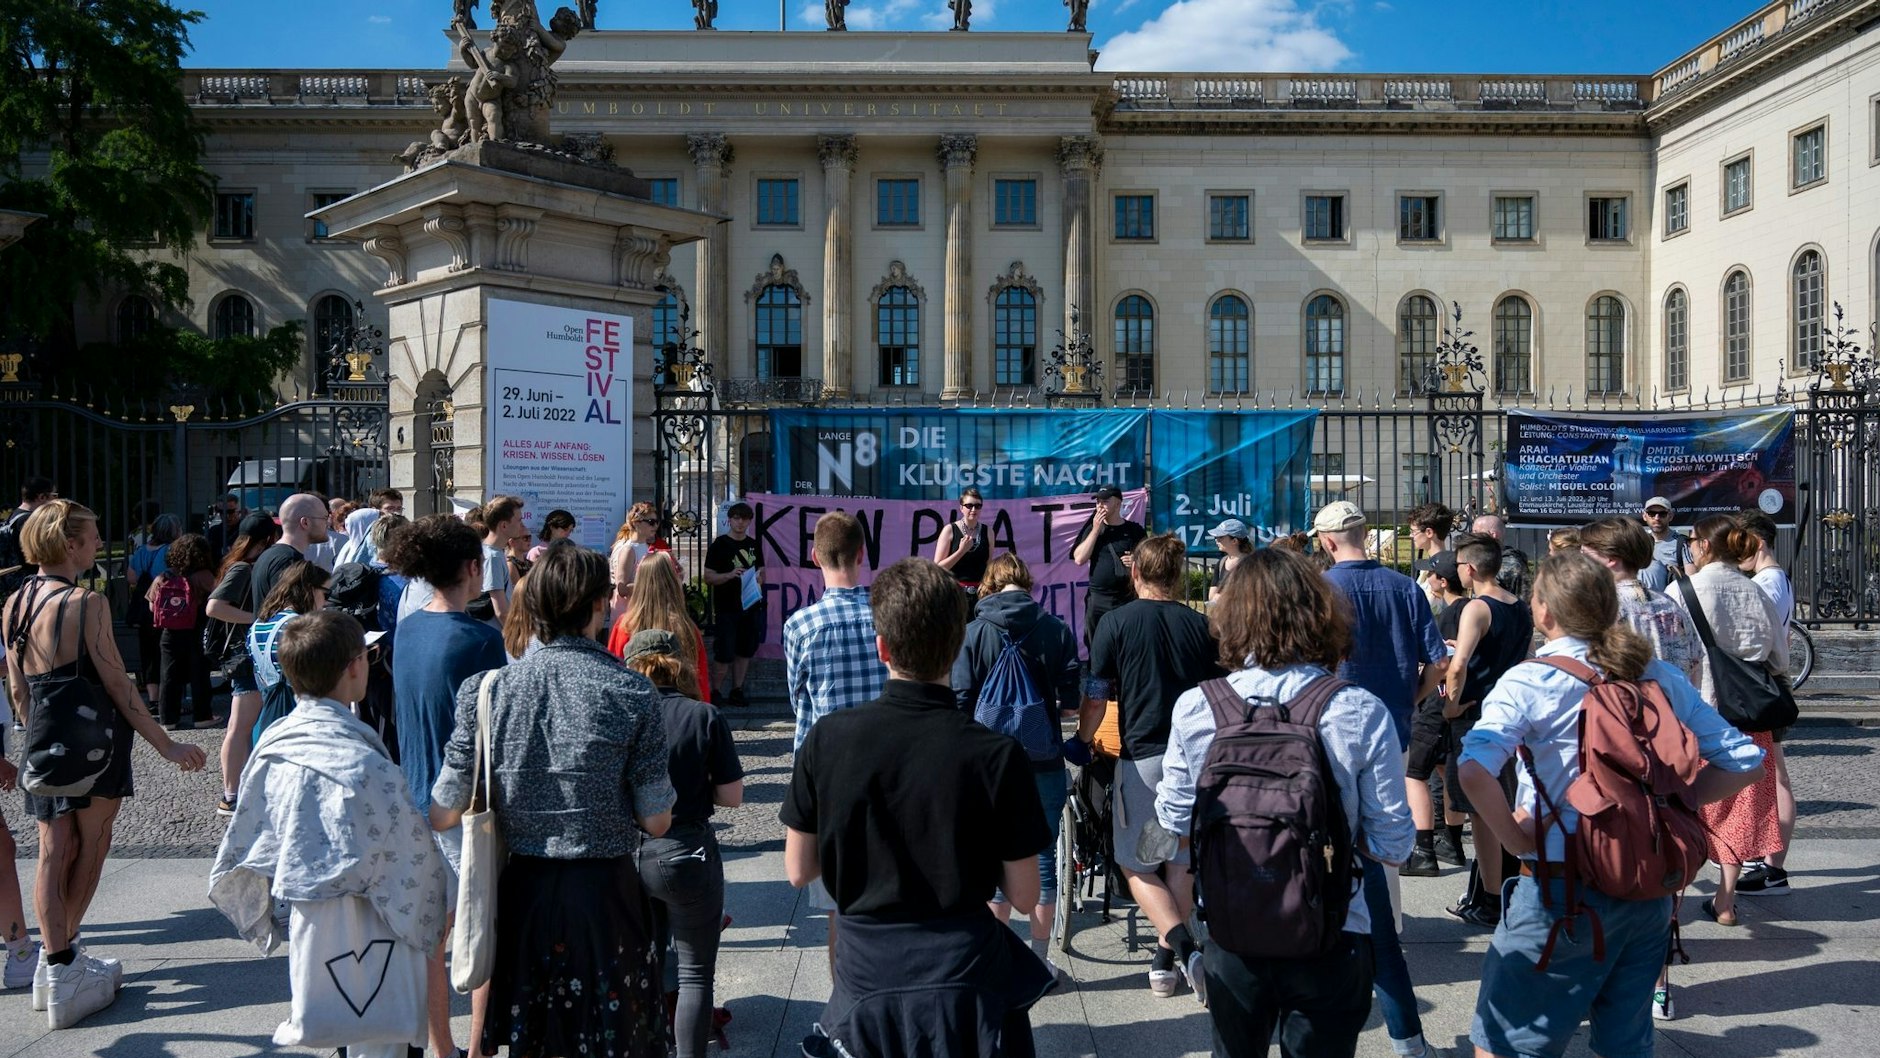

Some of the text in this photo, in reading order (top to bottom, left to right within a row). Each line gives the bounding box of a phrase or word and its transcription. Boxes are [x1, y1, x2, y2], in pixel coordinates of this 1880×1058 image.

[557, 102, 1012, 115] UMBOLDT UNIVERSITAET
[564, 325, 584, 335] Open
[546, 331, 584, 343] Humboldt
[503, 386, 523, 401] 29.
[526, 388, 553, 403] Juni
[503, 405, 576, 422] 2. Juli 2022
[1519, 423, 1567, 432] HUMBOLDTS
[1628, 426, 1687, 434] PHILHARMONIE
[818, 432, 851, 440] LANGE
[899, 426, 946, 449] DIE
[1519, 431, 1555, 439] LEITUNG:
[1557, 432, 1608, 440] CONSTANTIN
[503, 440, 592, 451] ALLES AUF ANFANG:
[1519, 445, 1548, 454] ARAM
[1647, 446, 1685, 455] DMITRI
[503, 451, 605, 462] KRISEN. WISSEN. LÖSEN
[1519, 455, 1610, 464] KHACHATURIAN
[1645, 452, 1758, 464] SCHOSTAKOWITSCH
[899, 457, 1131, 486] KLÜGSTE NACHT
[1519, 463, 1597, 472] Konzert für Violine
[1645, 464, 1693, 474] Symphonie
[1694, 464, 1707, 472] Nr.
[1718, 463, 1727, 471] in
[1519, 471, 1580, 480] und Orchester
[795, 481, 812, 489] DER
[1519, 482, 1546, 490] Solist:
[1175, 492, 1252, 517] 2. Juli
[754, 502, 884, 571] KEN
